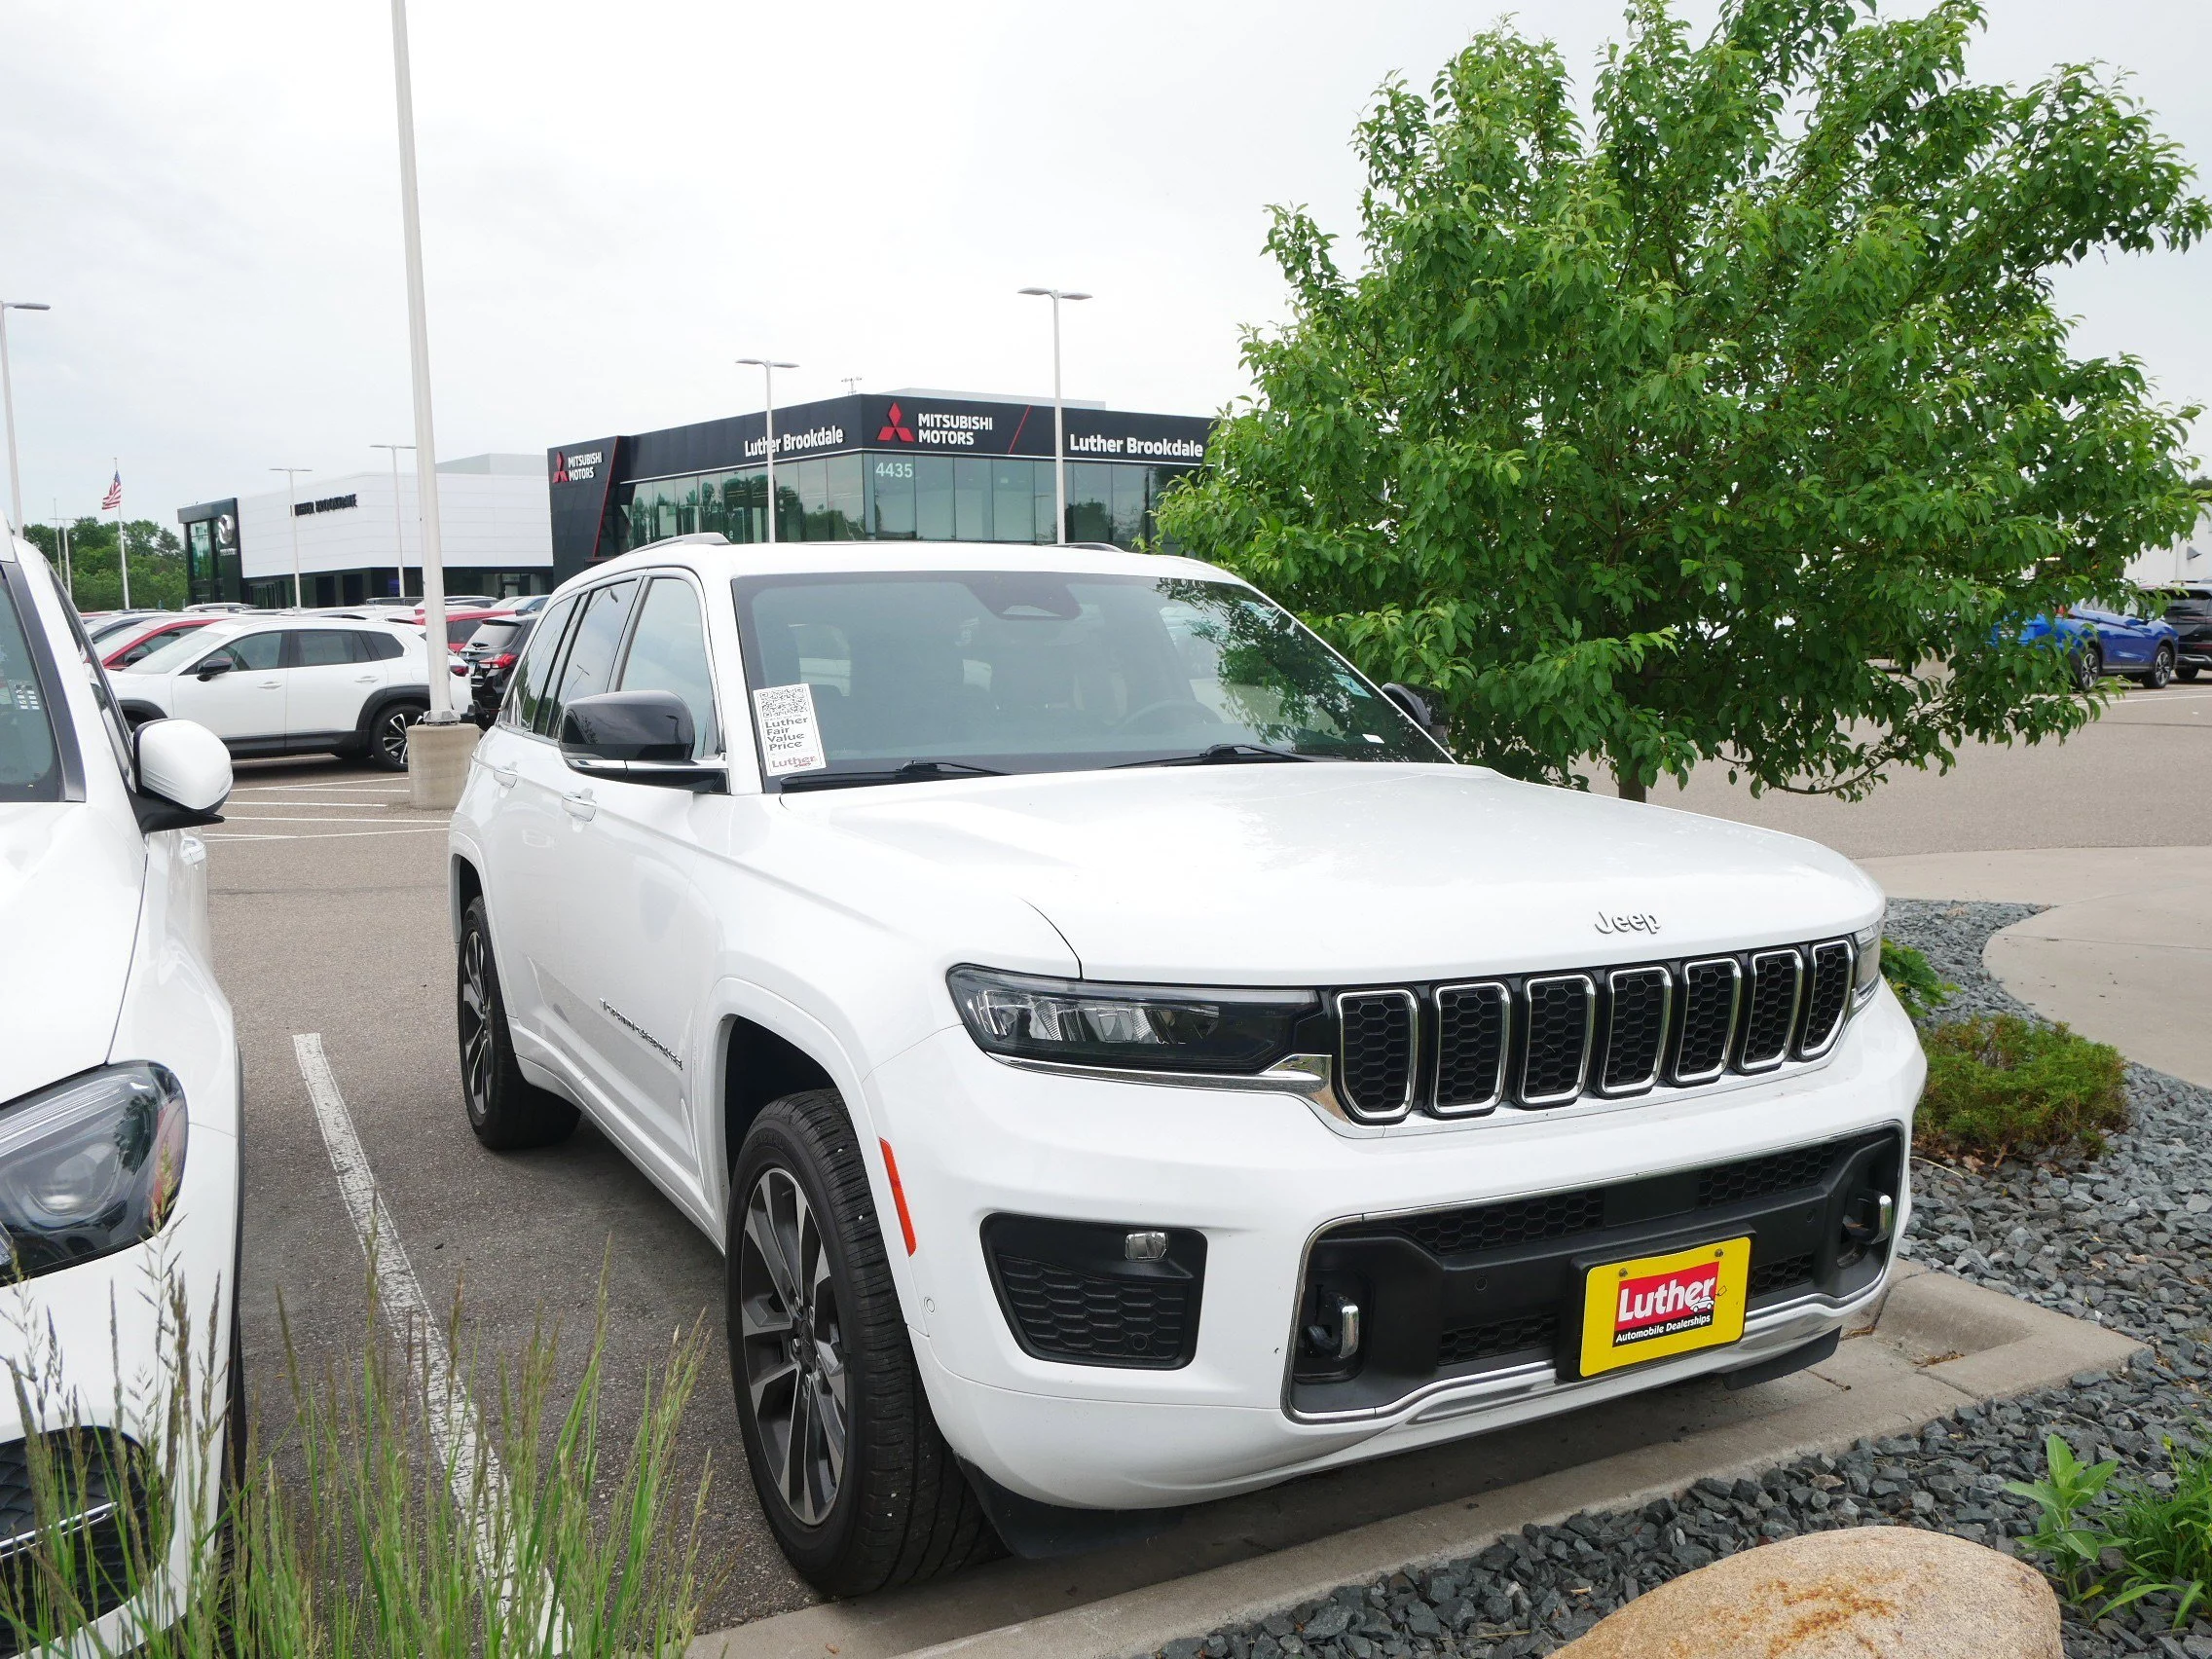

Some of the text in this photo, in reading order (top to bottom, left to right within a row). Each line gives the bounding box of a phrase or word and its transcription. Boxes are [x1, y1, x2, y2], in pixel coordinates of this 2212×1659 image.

[918, 413, 993, 430] MITSUBISHI
[783, 424, 844, 452] Brookdale
[918, 429, 975, 446] MOTORS
[1070, 433, 1203, 458] Luther Brookdale
[568, 451, 603, 467] MITSUBISHI
[568, 466, 595, 481] MOTORS
[875, 462, 913, 478] 4435
[765, 717, 808, 728] Luther
[766, 726, 790, 736] Fair
[767, 733, 805, 743] Value
[769, 741, 803, 752] Price
[771, 756, 816, 768] Luther
[1594, 910, 1662, 935] Jeep
[1618, 1276, 1716, 1322] Luther
[1615, 1314, 1711, 1344] Automobile Dealerships
